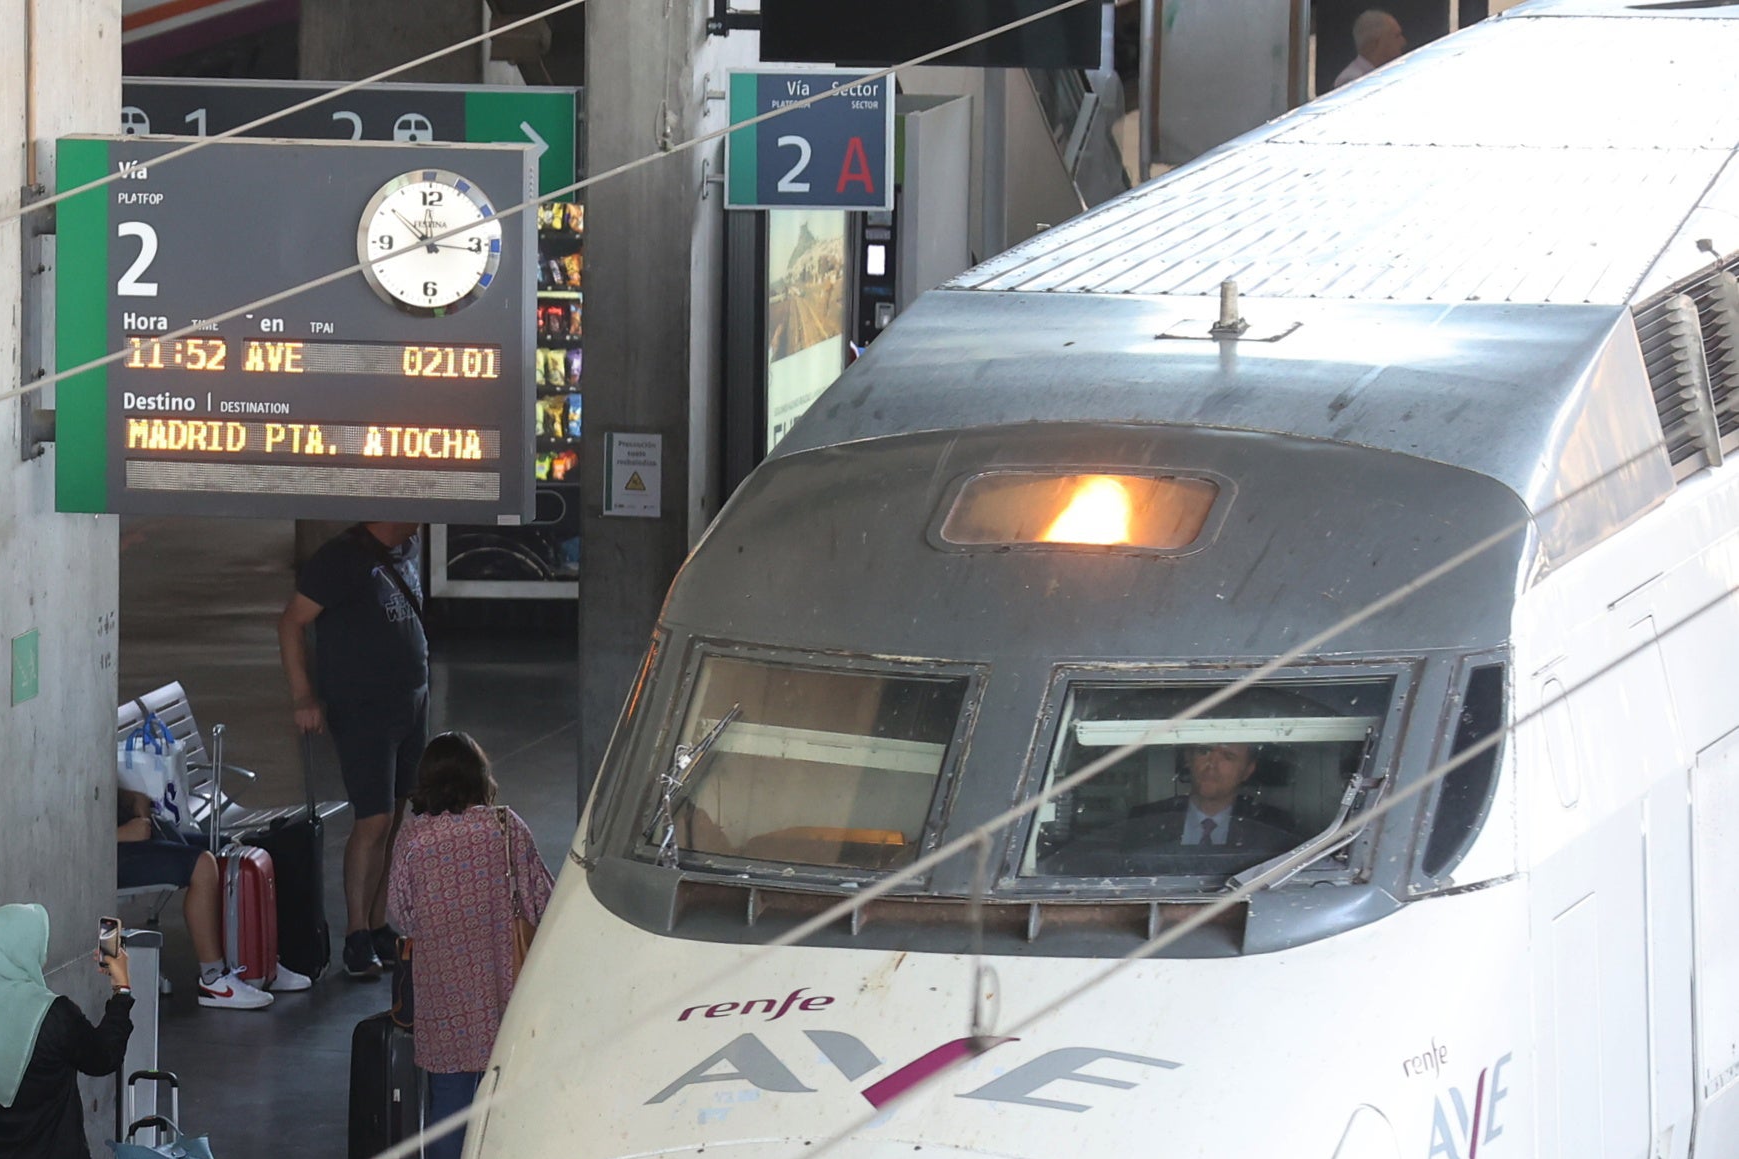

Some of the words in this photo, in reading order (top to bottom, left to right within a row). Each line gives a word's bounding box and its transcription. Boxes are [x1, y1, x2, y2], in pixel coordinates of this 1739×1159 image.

[787, 80, 809, 95] Vía
[832, 81, 878, 96] Sector
[851, 101, 878, 109] SECTOR
[118, 160, 148, 180] Vía
[777, 135, 812, 192] 2
[836, 137, 875, 193] A
[421, 191, 443, 206] 12
[379, 235, 393, 250] 9
[468, 237, 482, 253] 3
[117, 221, 159, 297] 2
[423, 281, 438, 297] 6
[123, 312, 168, 331] Hora
[126, 338, 226, 370] 11:52
[245, 341, 304, 373] AVE
[402, 346, 499, 378] 02101
[123, 391, 196, 411] Destino
[220, 400, 290, 415] DESTINATION
[128, 418, 247, 452] MADRID
[264, 423, 338, 456] PTA.
[363, 426, 482, 460] ATOCHA
[677, 987, 835, 1021] renfe
[1403, 1036, 1447, 1079] renfe
[644, 1029, 1183, 1113] AVE
